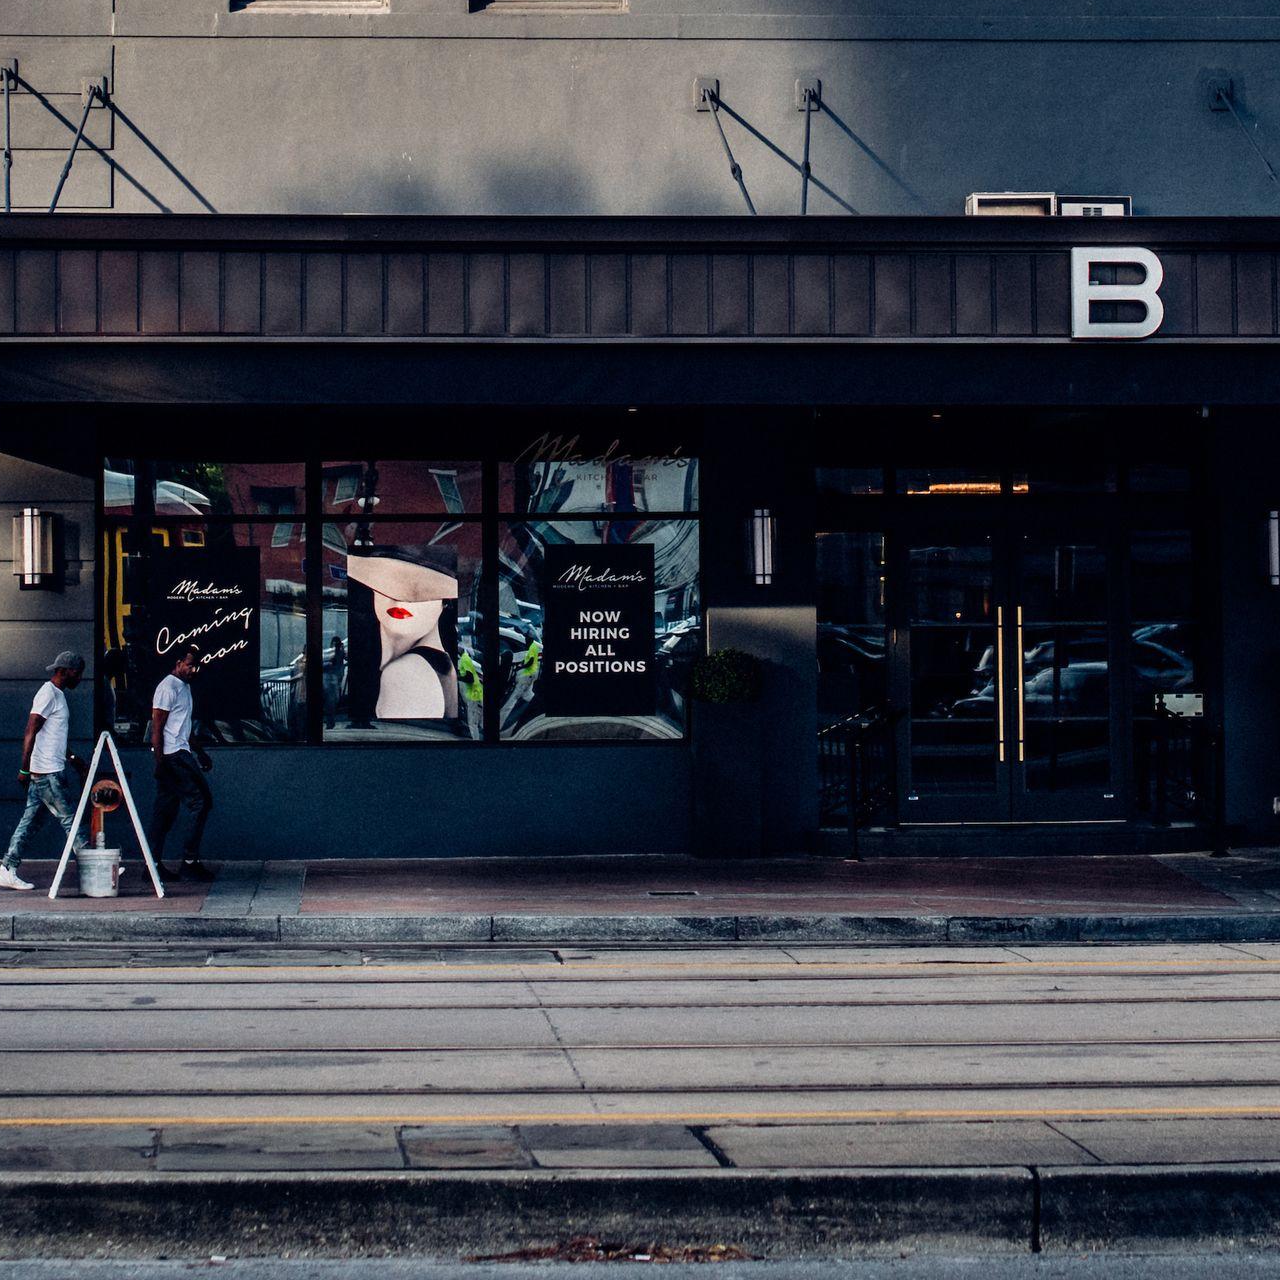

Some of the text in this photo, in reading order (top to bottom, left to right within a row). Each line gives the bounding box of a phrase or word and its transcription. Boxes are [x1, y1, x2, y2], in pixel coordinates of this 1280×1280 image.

[1071, 246, 1164, 338] B
[558, 564, 646, 591] Madam's
[171, 580, 243, 601] Madam's
[579, 610, 621, 623] NOW
[156, 607, 253, 654] Coming
[570, 627, 630, 640] HIRING
[584, 644, 616, 657] ALL
[555, 660, 646, 673] POSITIONS
